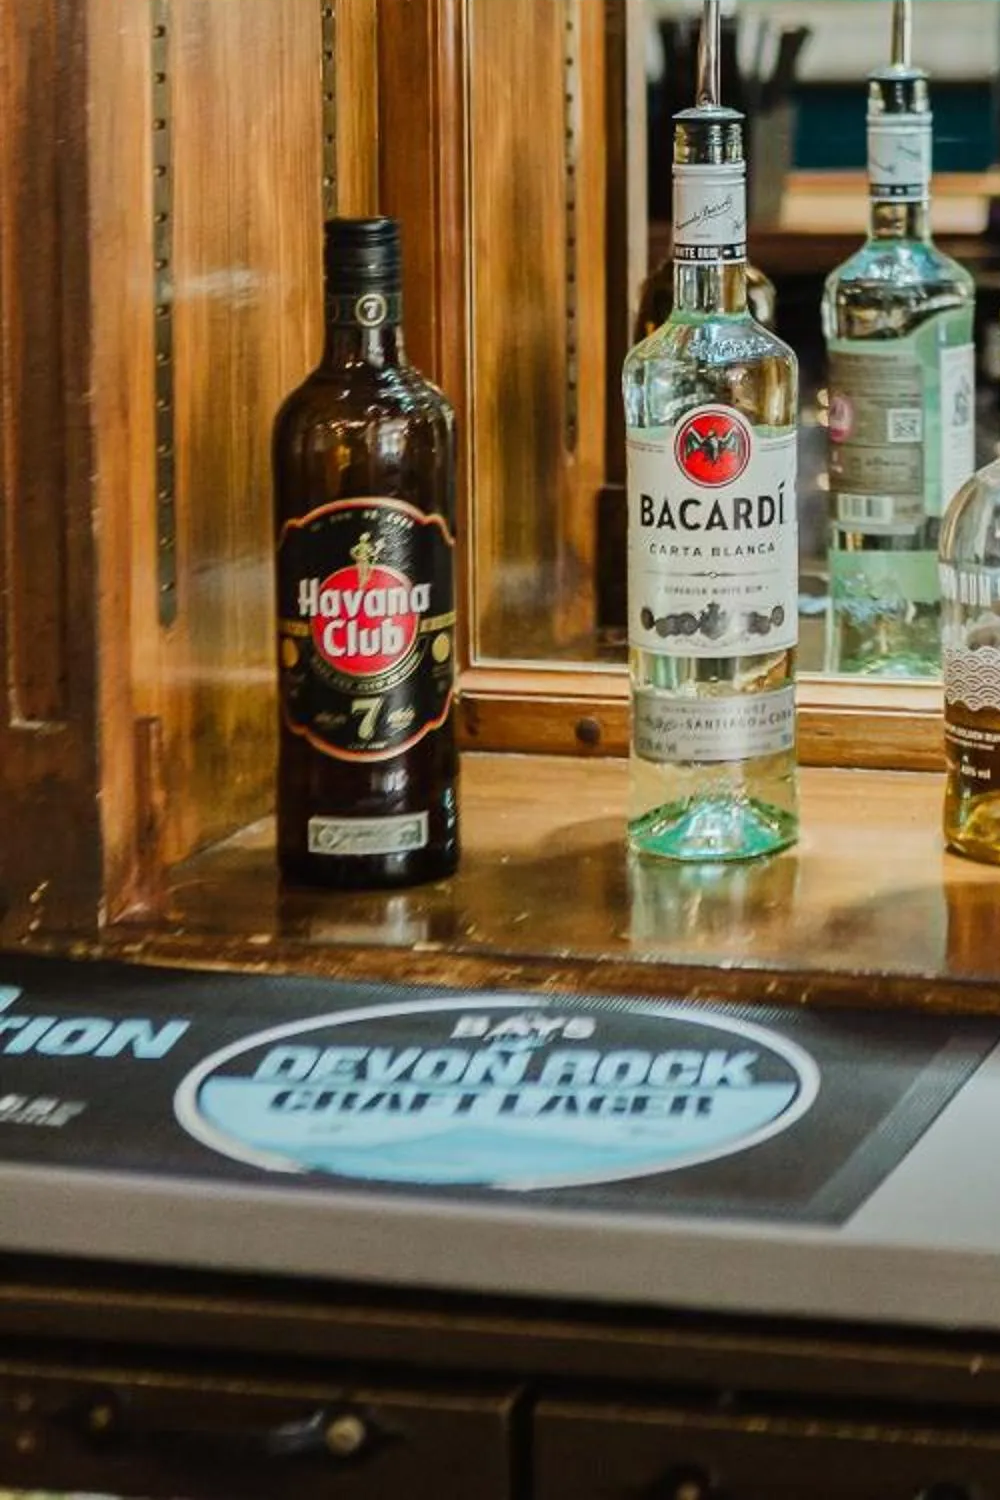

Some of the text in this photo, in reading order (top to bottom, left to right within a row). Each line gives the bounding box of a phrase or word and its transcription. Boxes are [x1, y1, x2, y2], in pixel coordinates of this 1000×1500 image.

[363, 300, 378, 319] 7
[640, 482, 785, 531] BACARDÍ
[650, 542, 776, 557] CARTA BLANCA
[298, 577, 432, 618] Havana
[323, 618, 407, 657] Club
[352, 697, 385, 740] 7
[252, 1043, 760, 1088] DEVON ROCK
